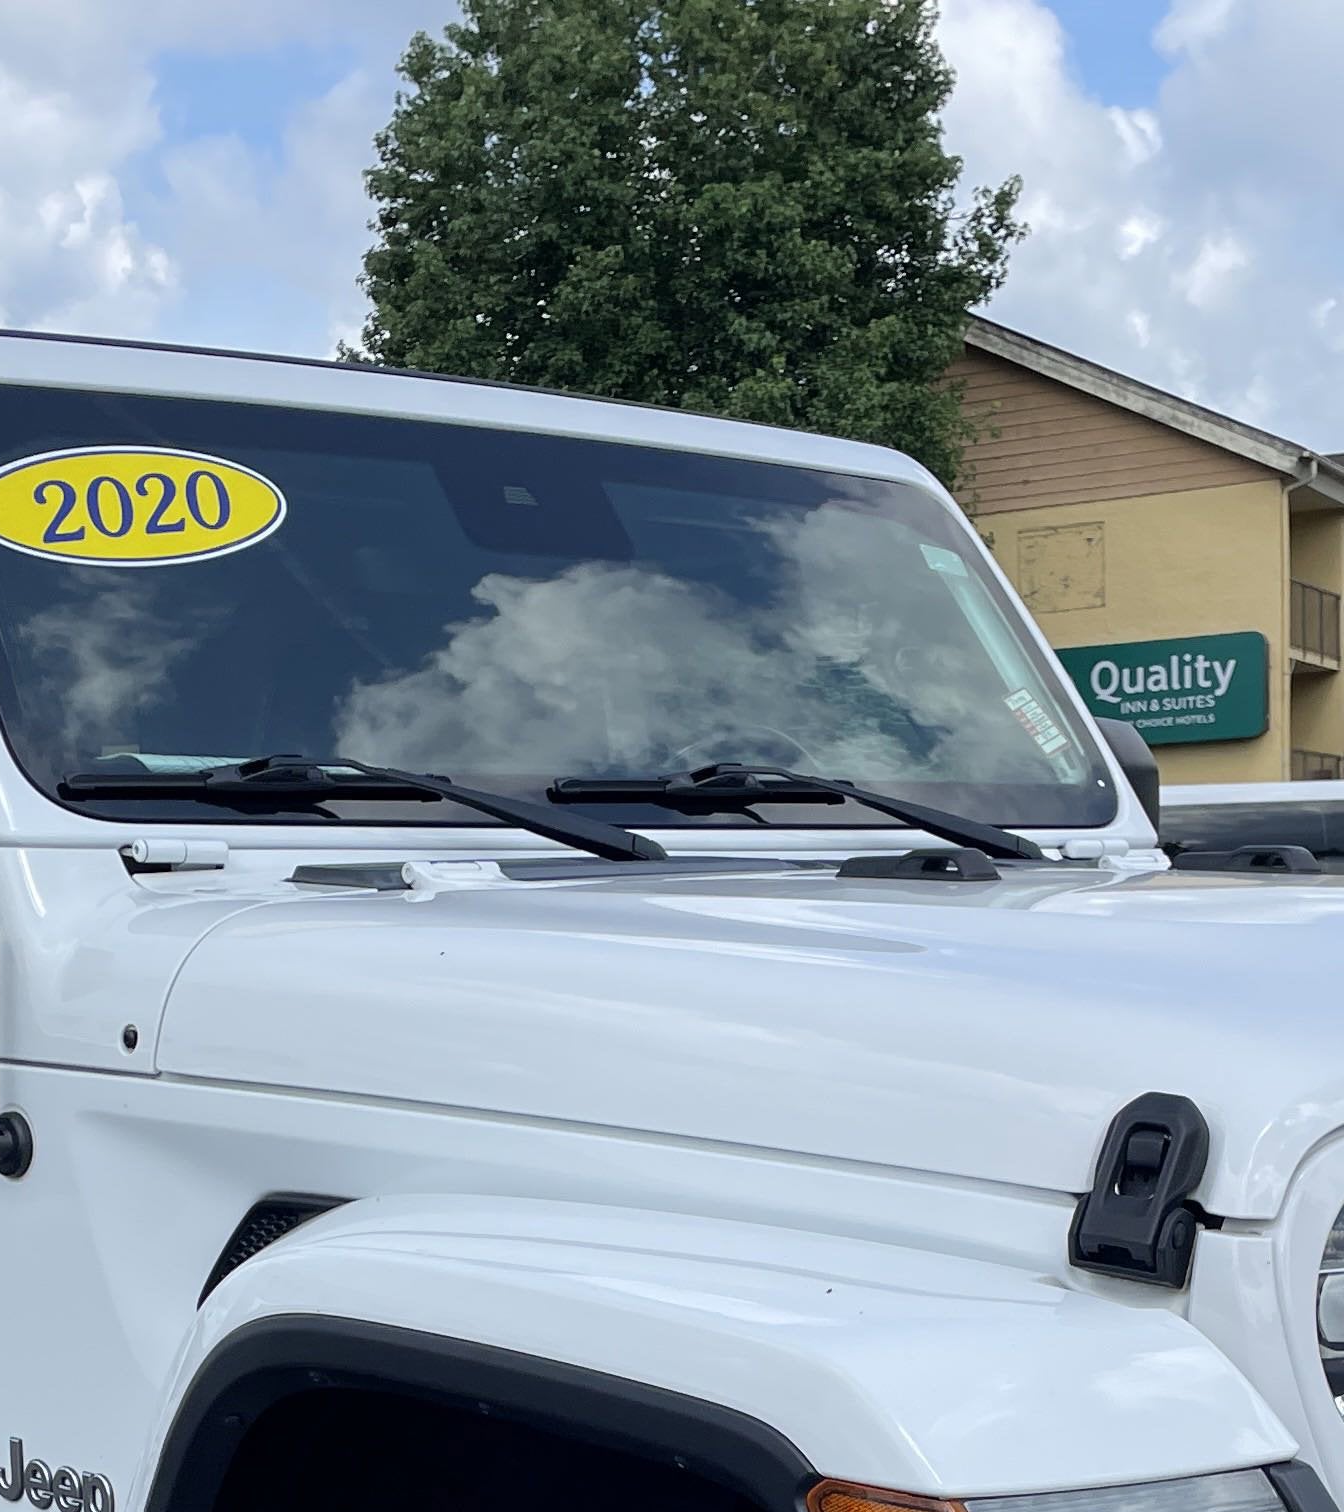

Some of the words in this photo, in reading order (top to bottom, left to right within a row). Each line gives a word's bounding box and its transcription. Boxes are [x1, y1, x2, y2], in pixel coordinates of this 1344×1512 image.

[33, 470, 231, 544] 2020
[1090, 653, 1237, 703] Quality
[1120, 701, 1147, 714] INN
[1149, 700, 1161, 712] &
[1162, 695, 1216, 711] SUITES
[1135, 716, 1174, 729] CHOICE
[1175, 713, 1216, 726] HOTELS
